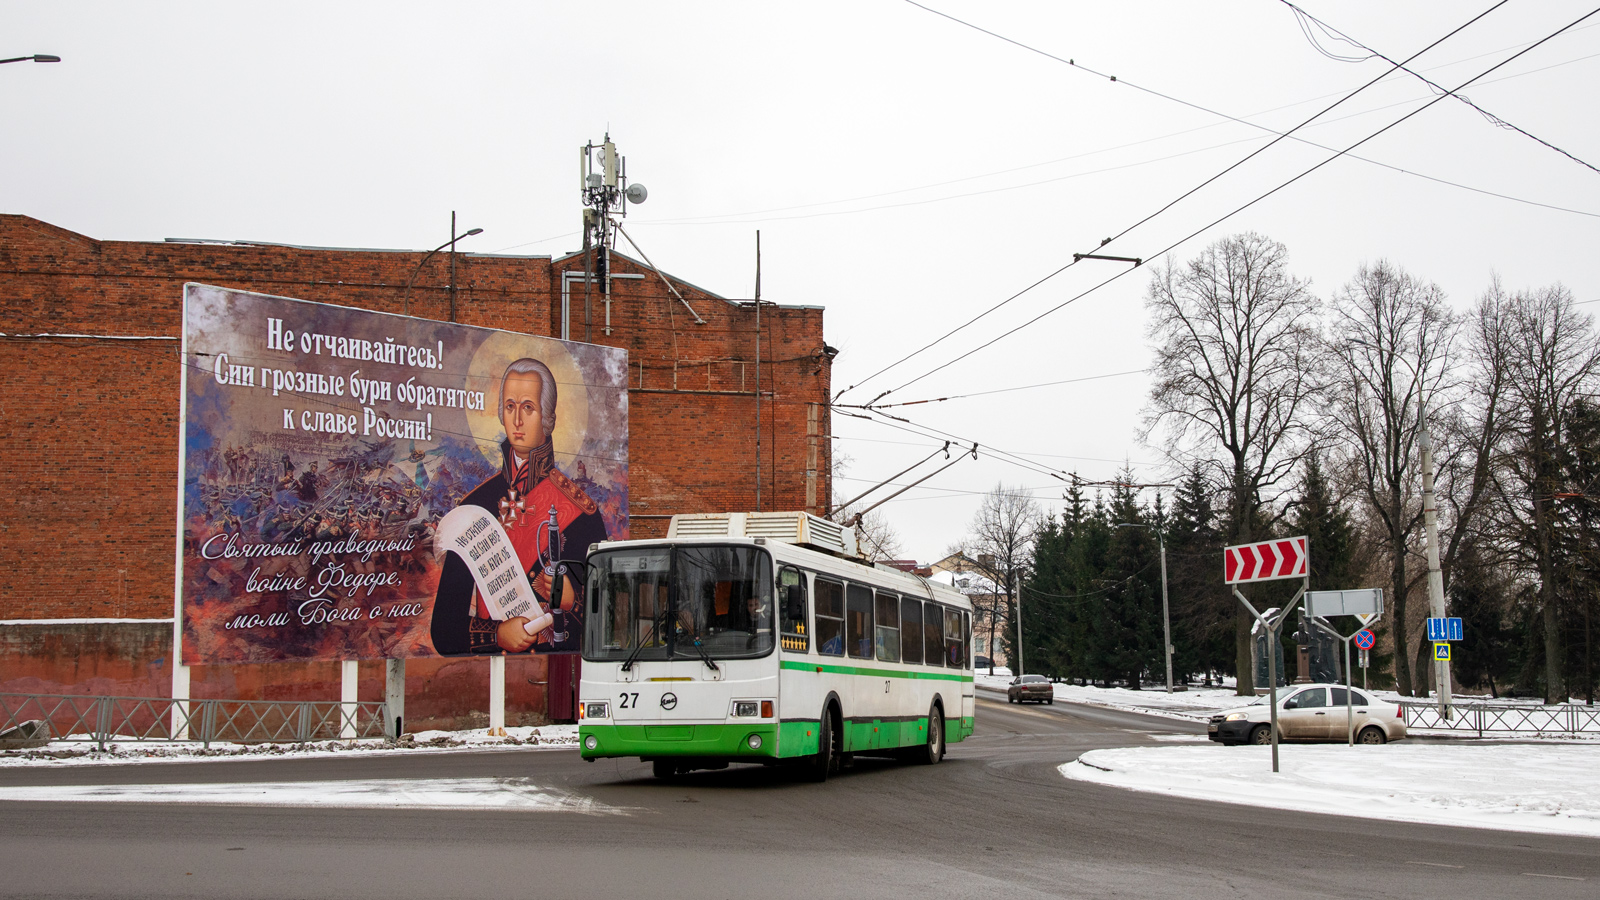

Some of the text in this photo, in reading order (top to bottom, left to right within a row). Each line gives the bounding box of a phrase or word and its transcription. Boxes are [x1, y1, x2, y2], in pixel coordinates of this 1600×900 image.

[267, 317, 443, 370] Не отчаивайтесь!
[214, 353, 485, 411] Сии грозные бури обратятся
[283, 406, 432, 441] к славе России!
[201, 529, 415, 565] Святый праведный
[245, 562, 402, 598] войне Федоре,
[225, 598, 424, 630] моли Бога о нас
[619, 692, 640, 708] 27
[885, 680, 891, 694] 27
